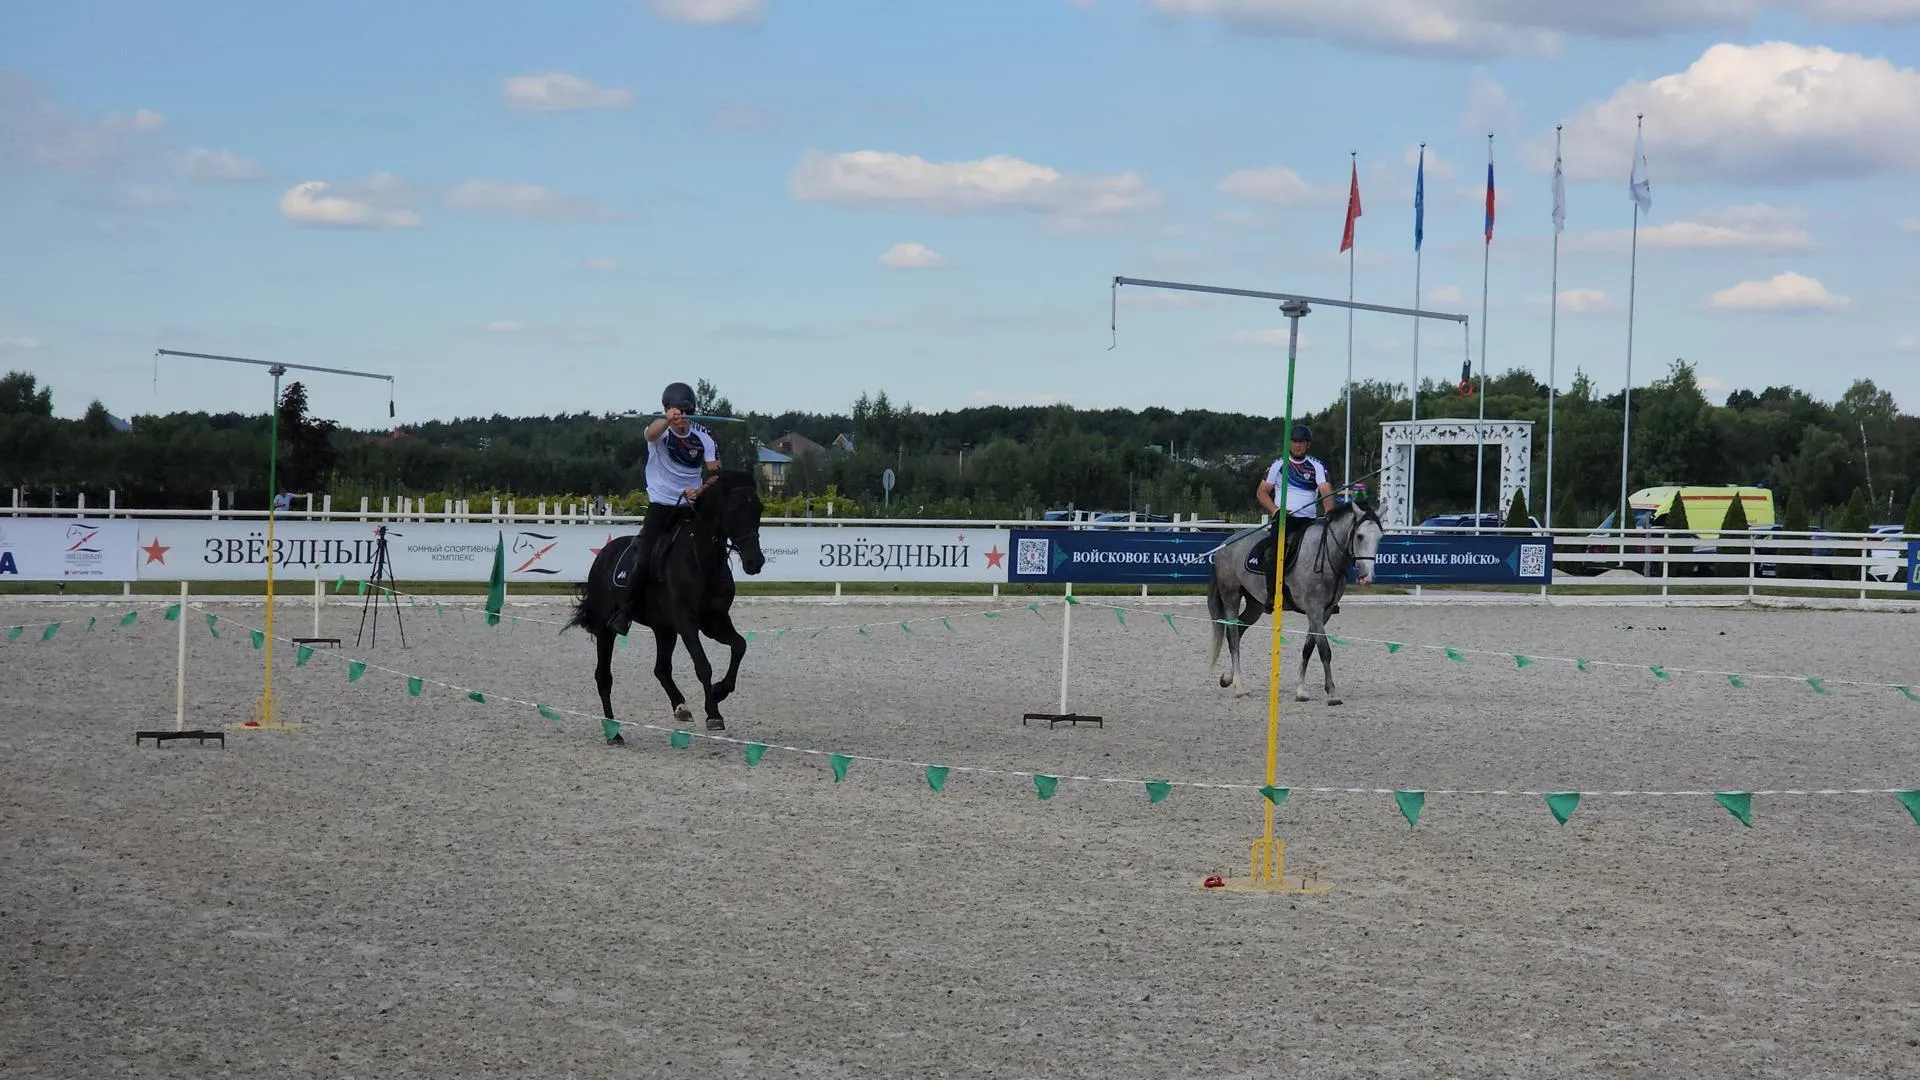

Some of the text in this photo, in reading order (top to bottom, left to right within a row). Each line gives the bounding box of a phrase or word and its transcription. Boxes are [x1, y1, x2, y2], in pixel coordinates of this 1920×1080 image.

[407, 544, 442, 553] КОННЫЙ
[819, 538, 970, 572] ЗВЁЗДНЫЙ
[1072, 549, 1150, 564] ВОЙСКОВОЕ
[1153, 552, 1206, 565] КАЗАЧЬЕ
[1401, 553, 1447, 565] КАЗАЧЬЕ
[1450, 551, 1500, 565] ВОЙСКО»
